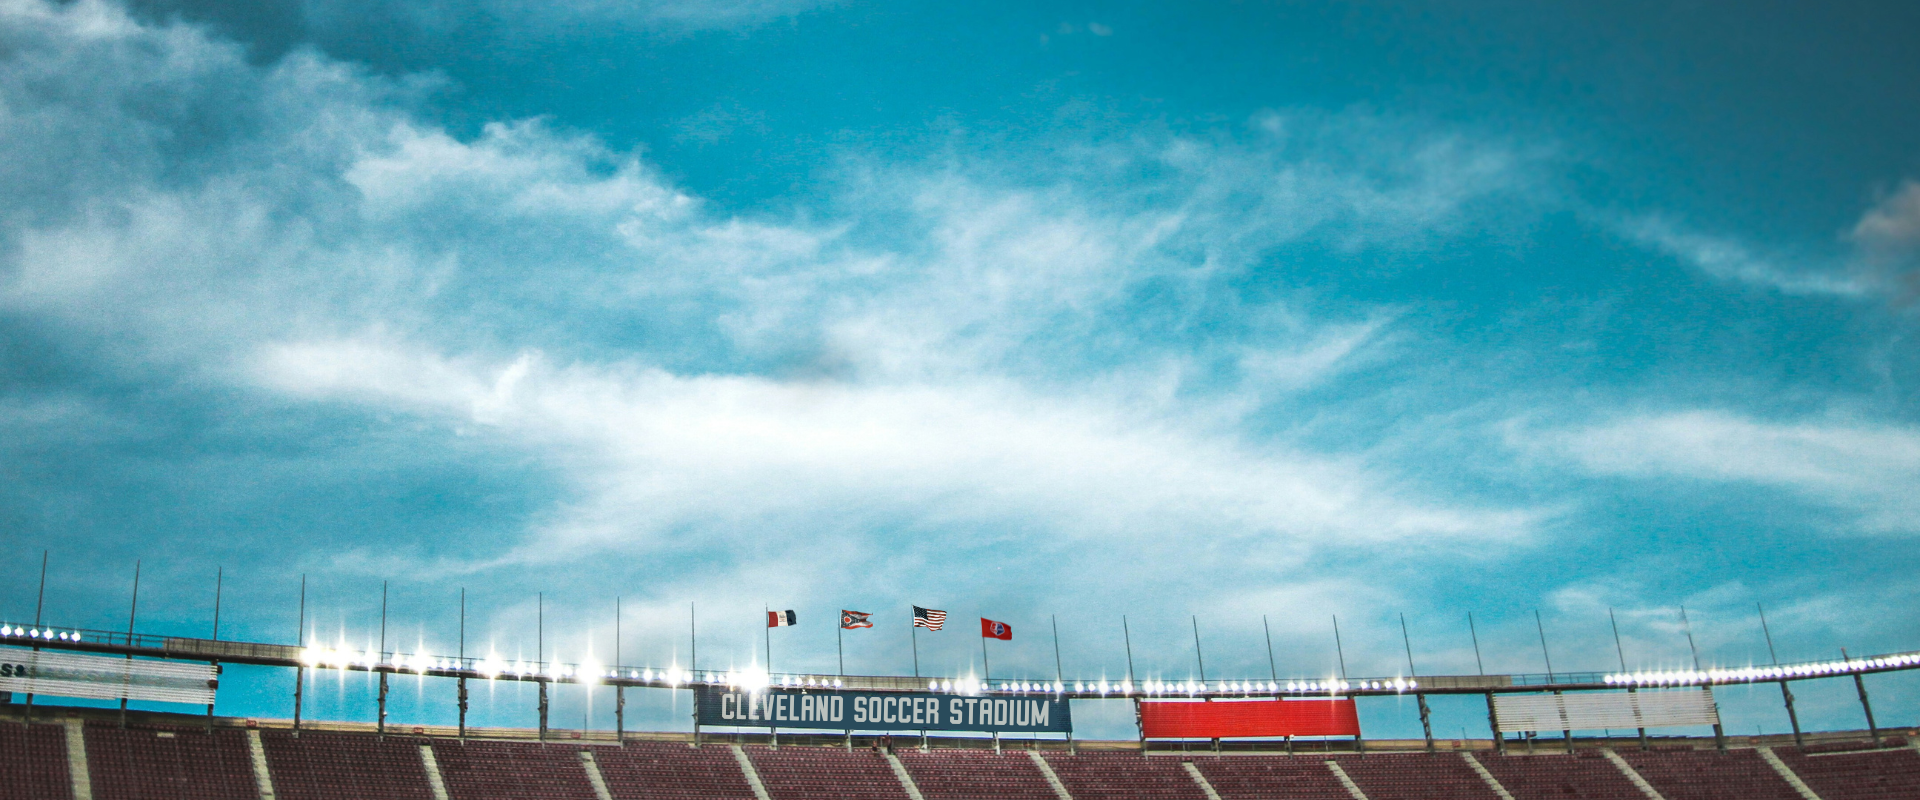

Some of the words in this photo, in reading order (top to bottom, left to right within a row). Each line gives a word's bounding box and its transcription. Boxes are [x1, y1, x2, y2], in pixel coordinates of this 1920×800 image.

[722, 693, 843, 722] CLEVELAND
[854, 696, 939, 724] SOCCER
[950, 698, 1049, 726] STADIUM
